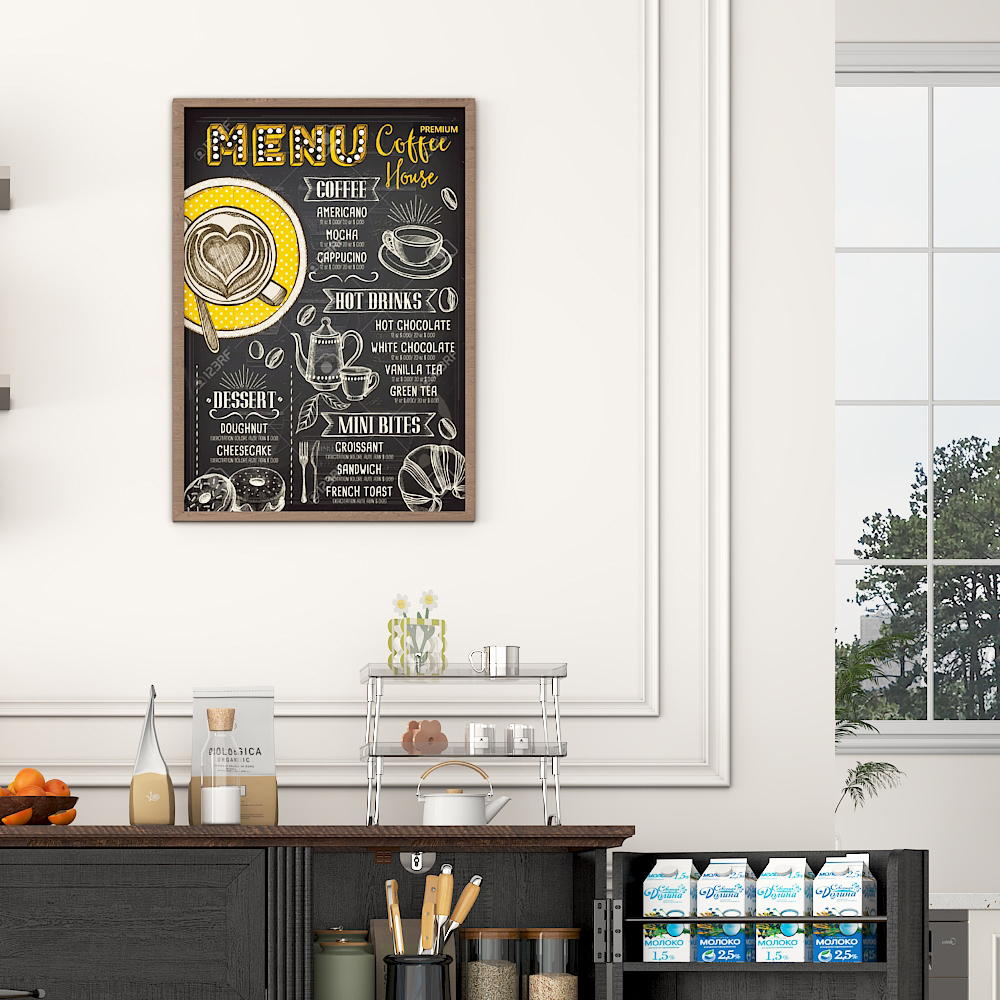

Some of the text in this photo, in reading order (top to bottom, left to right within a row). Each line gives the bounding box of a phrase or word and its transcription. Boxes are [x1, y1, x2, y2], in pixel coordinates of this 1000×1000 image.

[206, 123, 369, 167] MENU
[375, 124, 452, 164] Coffee
[386, 158, 438, 190] House
[316, 180, 367, 198] COFFEE
[316, 206, 368, 218] AMERICANO
[326, 229, 358, 240] MOCHA
[317, 252, 368, 263] CAPPUCINO
[336, 292, 422, 310] HOT DRINKS
[375, 320, 451, 331] HOT CHOCOLATE
[371, 342, 455, 353] WHITE CHOCOLATE
[385, 364, 442, 375] VANILLA TEA
[390, 386, 437, 396] GREEN TEA
[213, 391, 276, 408] DESSERT
[220, 423, 268, 434] DOUGHNUT
[338, 416, 421, 434] MINI BITES
[216, 445, 272, 456] CHEESECAKE
[335, 442, 384, 453] CROISSANT
[337, 464, 382, 475] SANDWICH
[326, 486, 393, 497] FRENCH TOAST
[644, 887, 682, 900] Долина
[699, 887, 739, 900] Долина
[757, 886, 797, 900] Долина
[815, 886, 857, 899] Долина
[652, 950, 675, 960] 1,5%
[718, 950, 740, 960] 2,5%
[766, 951, 788, 961] 1,5%
[834, 950, 858, 960] 2,5%
